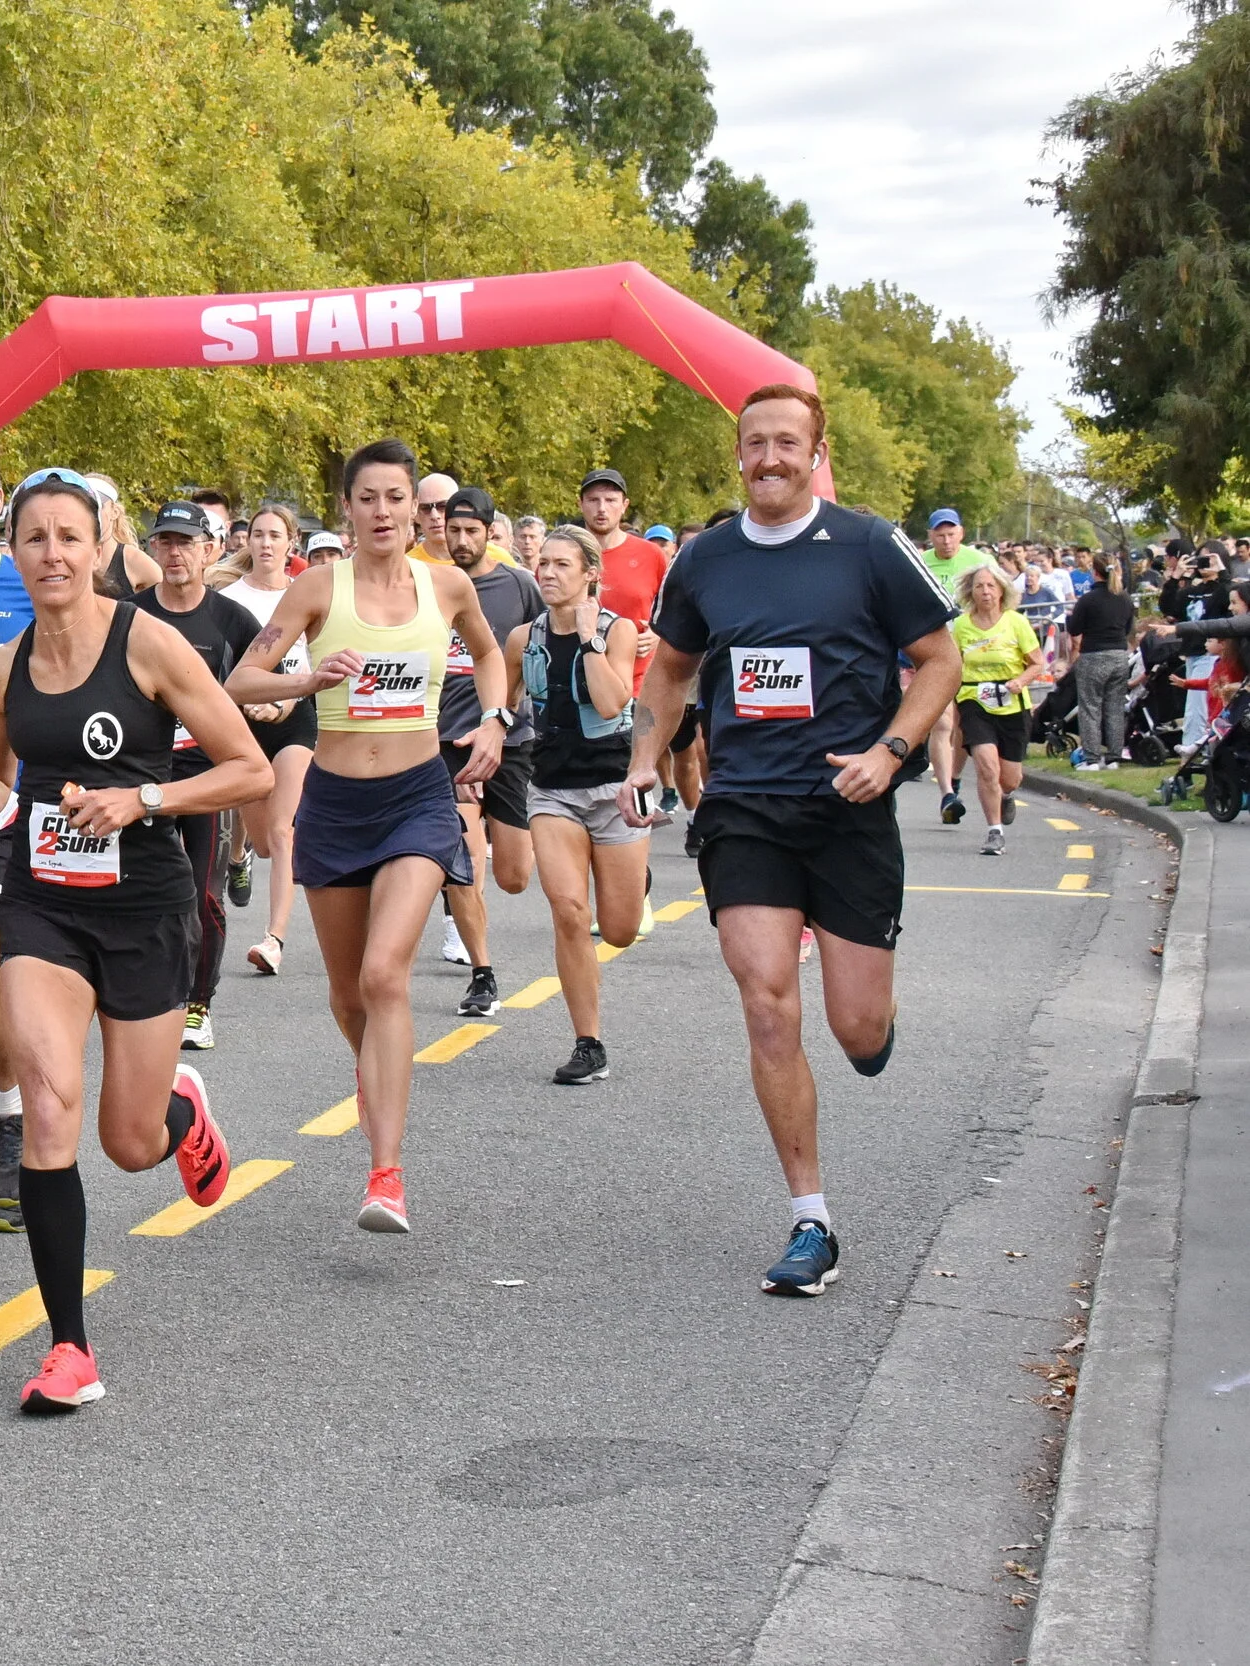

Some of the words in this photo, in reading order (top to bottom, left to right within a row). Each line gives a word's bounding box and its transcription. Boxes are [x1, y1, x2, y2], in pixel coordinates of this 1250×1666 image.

[201, 282, 474, 362] START
[362, 663, 408, 676] CITY
[741, 659, 785, 673] CITY
[354, 675, 423, 695] 2SURF
[738, 672, 804, 693] 2SURF
[42, 816, 81, 834] CIT
[36, 831, 111, 855] 2SURF
